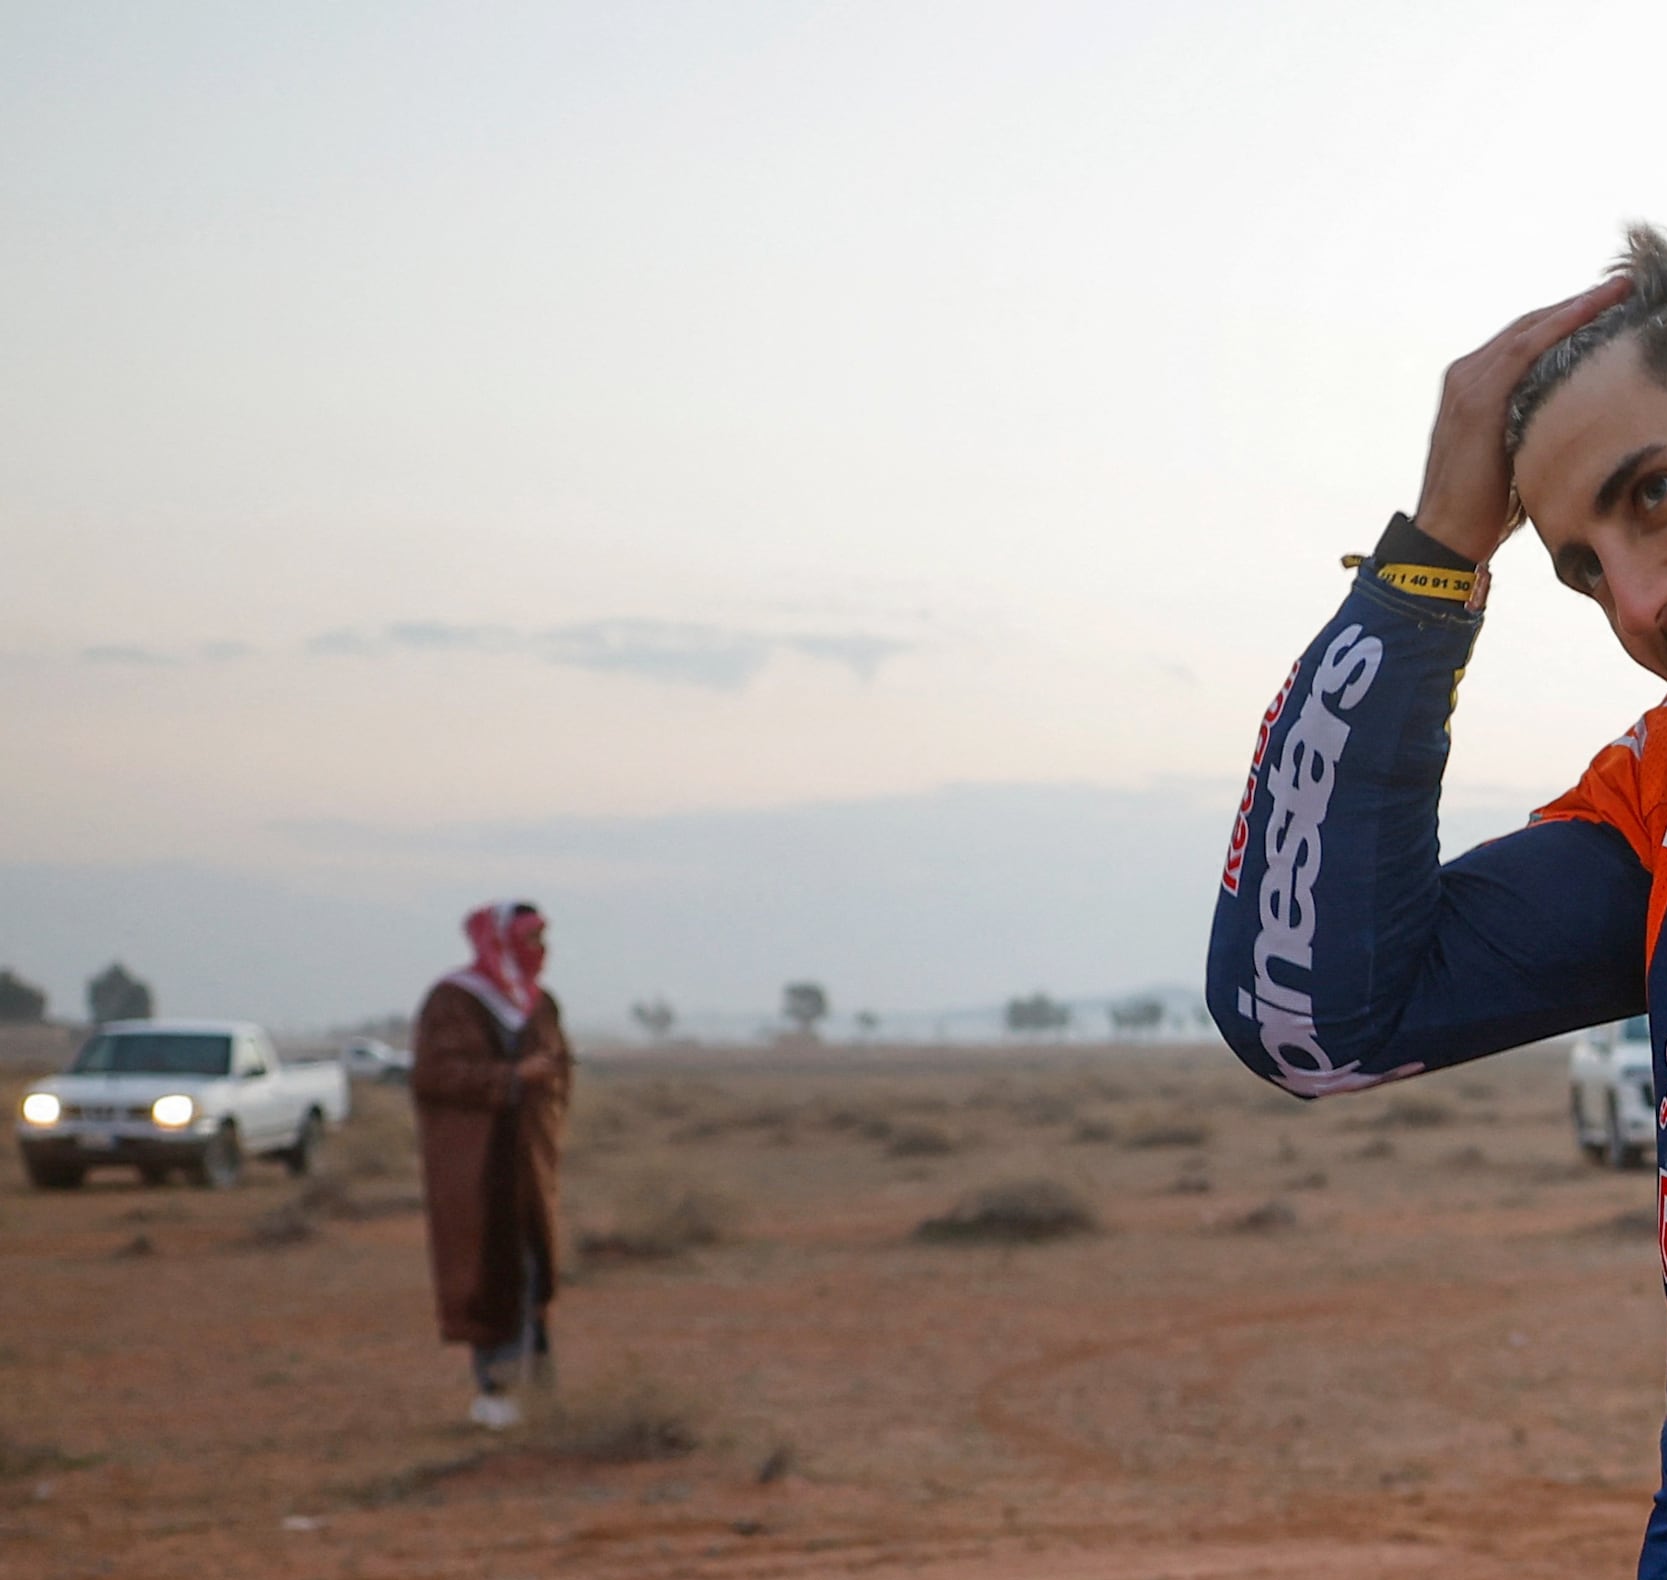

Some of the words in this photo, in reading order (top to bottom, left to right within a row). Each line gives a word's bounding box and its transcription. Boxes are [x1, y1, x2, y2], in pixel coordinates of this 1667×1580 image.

[1410, 575, 1427, 587] 40
[1453, 579, 1471, 592] 30
[1237, 622, 1426, 1100] pinestars
